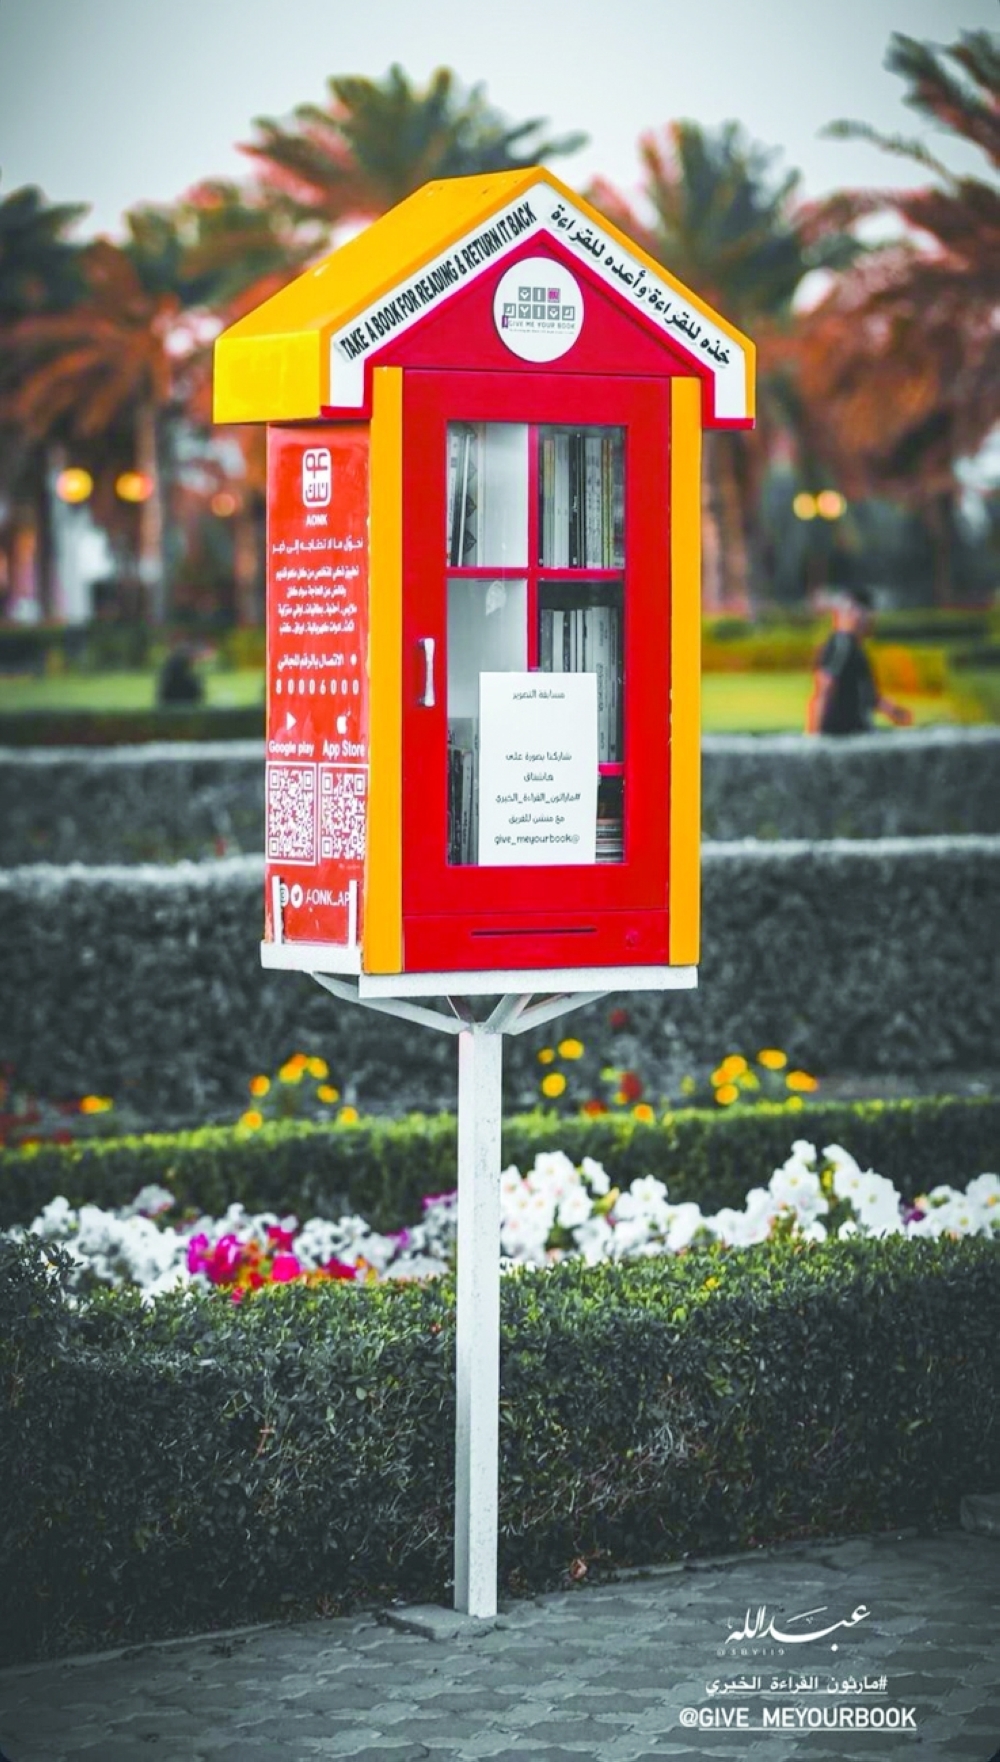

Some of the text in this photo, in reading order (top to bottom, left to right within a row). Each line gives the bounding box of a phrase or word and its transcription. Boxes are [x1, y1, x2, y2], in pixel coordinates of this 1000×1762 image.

[551, 204, 605, 258] للقراءة
[340, 201, 537, 360] TAKE A BOOK FOR READING & RETURN IT BACK
[648, 288, 701, 340] للقراءة
[700, 340, 730, 364] خذه
[269, 739, 365, 760] Google play App Store
